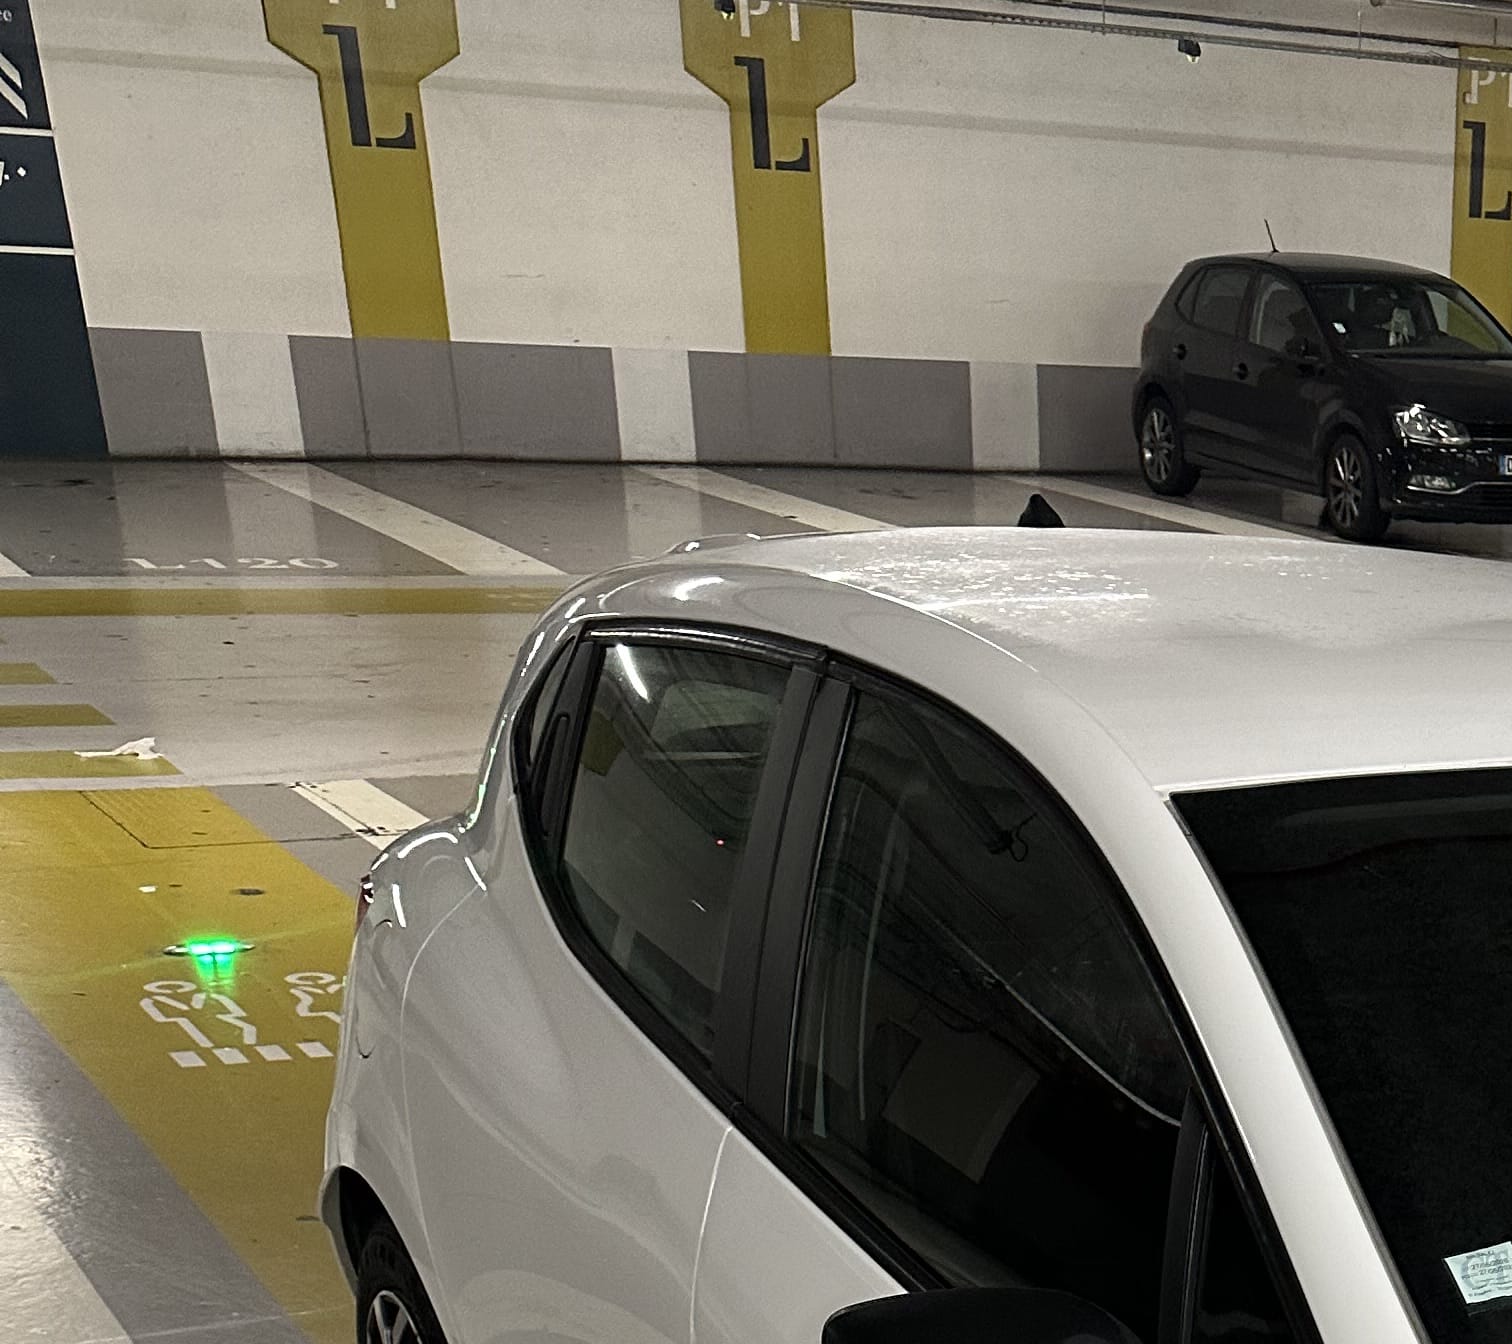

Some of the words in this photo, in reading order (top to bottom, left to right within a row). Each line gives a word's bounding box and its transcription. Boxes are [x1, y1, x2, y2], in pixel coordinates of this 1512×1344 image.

[322, 24, 416, 149] L
[734, 56, 811, 172] L
[1463, 120, 1512, 220] L
[121, 557, 340, 569] L120
